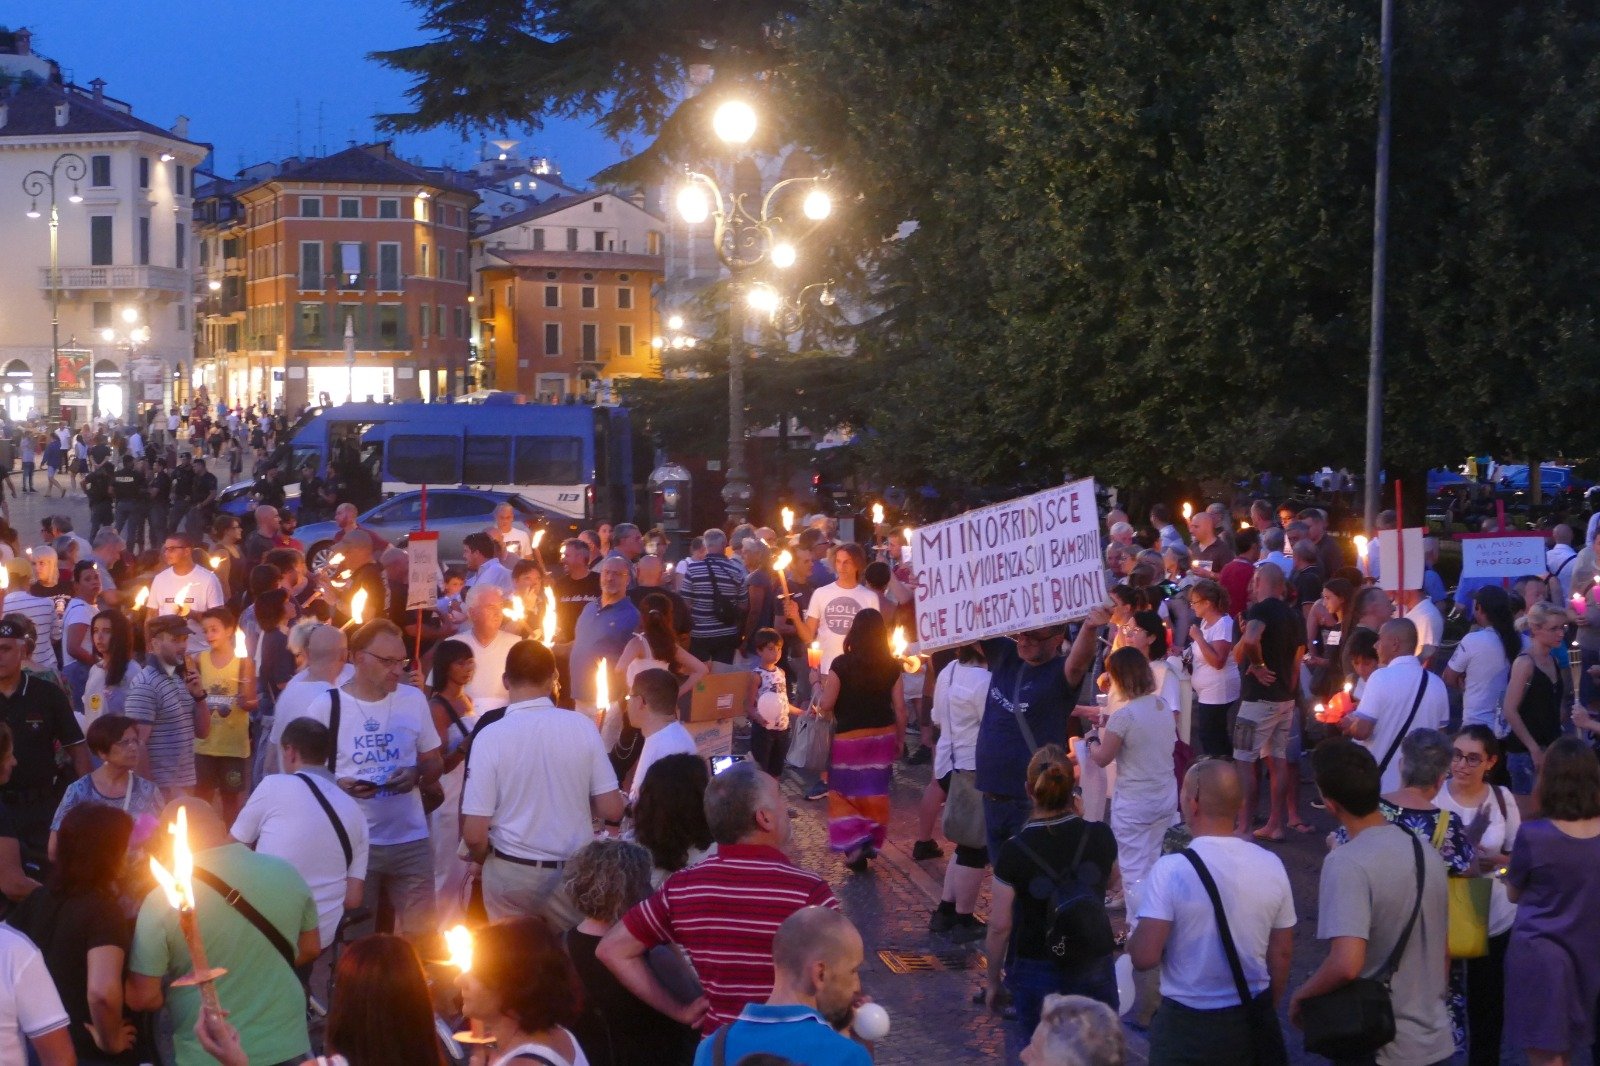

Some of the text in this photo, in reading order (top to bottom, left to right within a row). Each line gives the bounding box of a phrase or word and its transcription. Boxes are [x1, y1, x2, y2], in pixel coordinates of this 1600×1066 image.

[557, 493, 580, 501] 113
[920, 492, 1082, 564] MI INORRIDISCE
[917, 529, 1100, 602] SIA LA VIOLENZA SUI BAMBINI
[1475, 556, 1531, 566] PROCESSO
[918, 607, 948, 642] CHE
[1022, 581, 1045, 616] DEI
[828, 619, 852, 628] STE
[353, 733, 394, 750] KEEP
[351, 748, 400, 765] CALM
